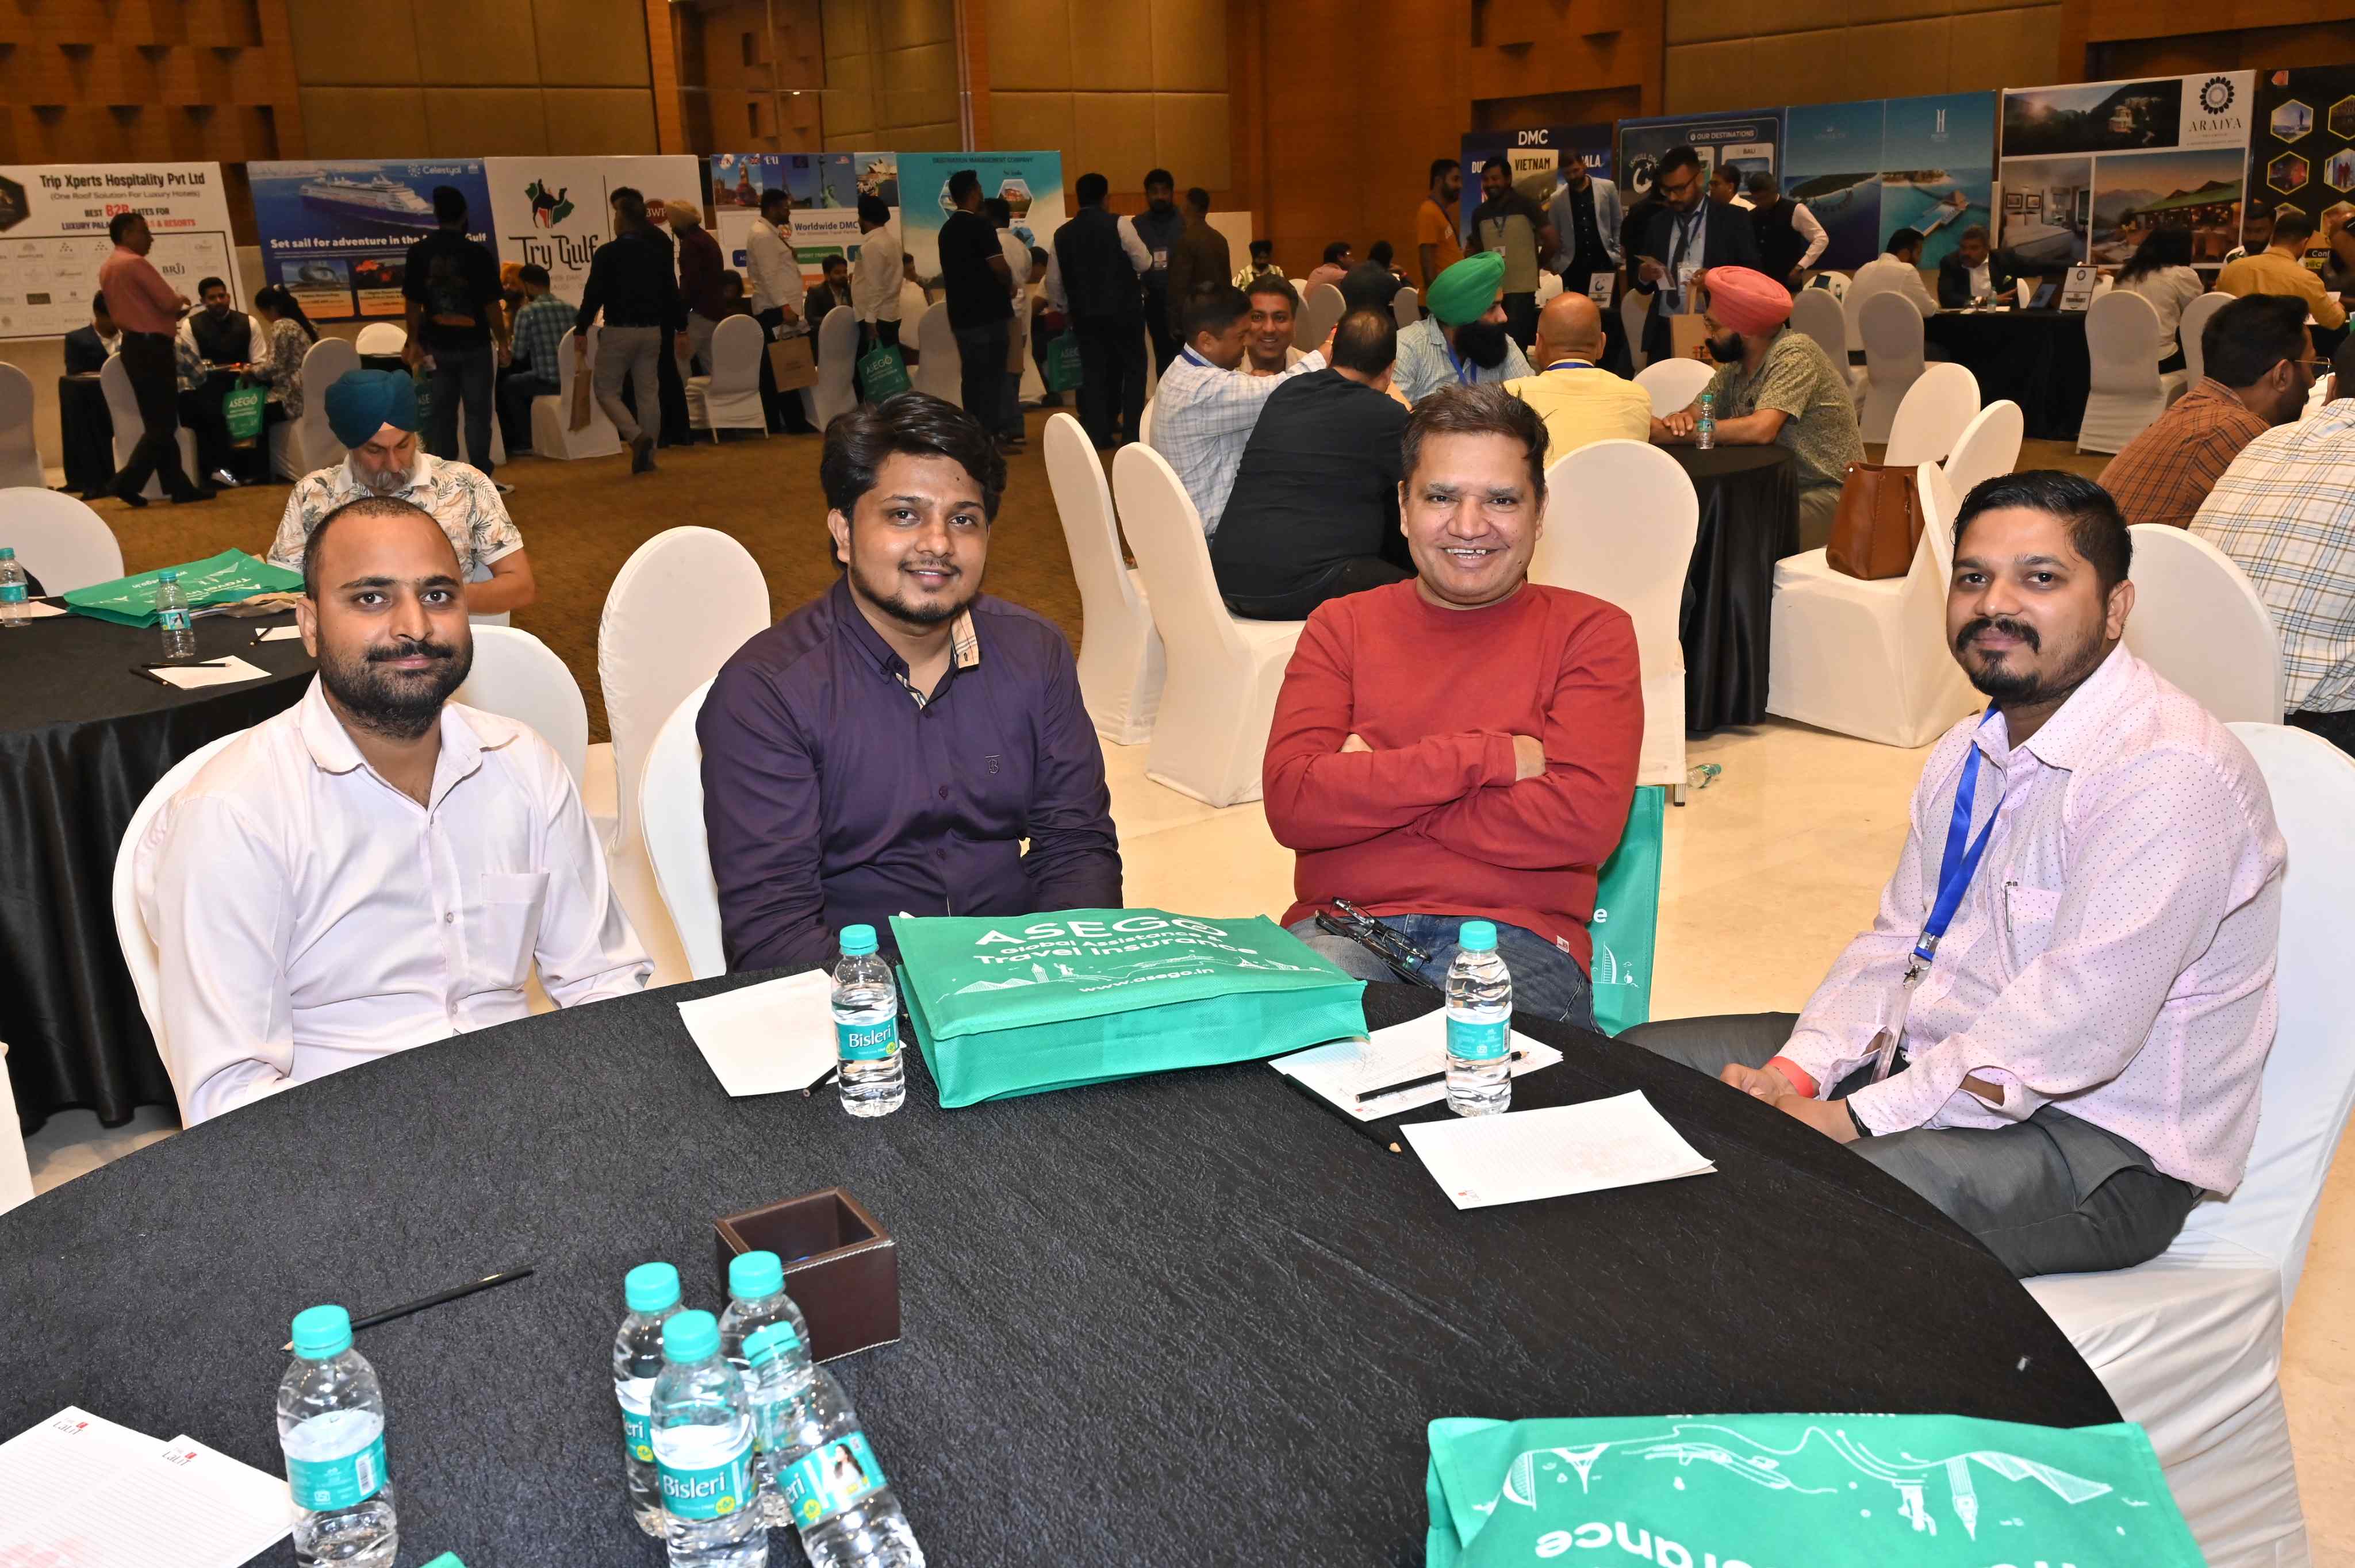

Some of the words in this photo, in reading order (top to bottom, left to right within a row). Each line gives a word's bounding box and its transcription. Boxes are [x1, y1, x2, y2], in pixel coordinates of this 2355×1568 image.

[2189, 117, 2242, 132] ARAIYA
[1518, 129, 1549, 145] DMC
[1711, 130, 1754, 139] DESTINATIONS
[1514, 157, 1551, 171] VIETNAM
[40, 175, 62, 190] Trip
[66, 174, 103, 189] Xperts
[106, 172, 164, 189] Hospitality
[168, 173, 186, 185] Pvt
[189, 172, 206, 185] Ltd
[51, 193, 70, 201] (One
[94, 191, 127, 199] Solution
[144, 190, 171, 199] Luxury
[85, 209, 102, 217] BEST
[105, 204, 130, 217] B2B
[156, 207, 170, 215] FOR
[62, 222, 90, 230] LUXURY
[92, 221, 111, 229] PALA
[164, 218, 196, 228] RESORTS
[795, 221, 838, 230] Worldwide
[839, 221, 858, 229] DMC
[270, 239, 290, 248] Set
[292, 238, 311, 248] sail
[313, 237, 329, 247] for
[332, 236, 387, 247] adventure
[389, 235, 400, 244] in
[402, 235, 420, 244] the
[508, 236, 553, 272] Try
[550, 234, 599, 271] Gulf
[229, 393, 258, 409] ASEGO
[975, 916, 1228, 945] ASEGO
[973, 947, 1082, 964] Travel
[1090, 937, 1259, 956] Insurance
[1000, 940, 1076, 954] Global
[1082, 931, 1202, 948] Assistance
[1079, 967, 1215, 993] www.asego.in
[849, 1024, 891, 1048] Bisleri
[663, 1471, 726, 1500] Bisleri
